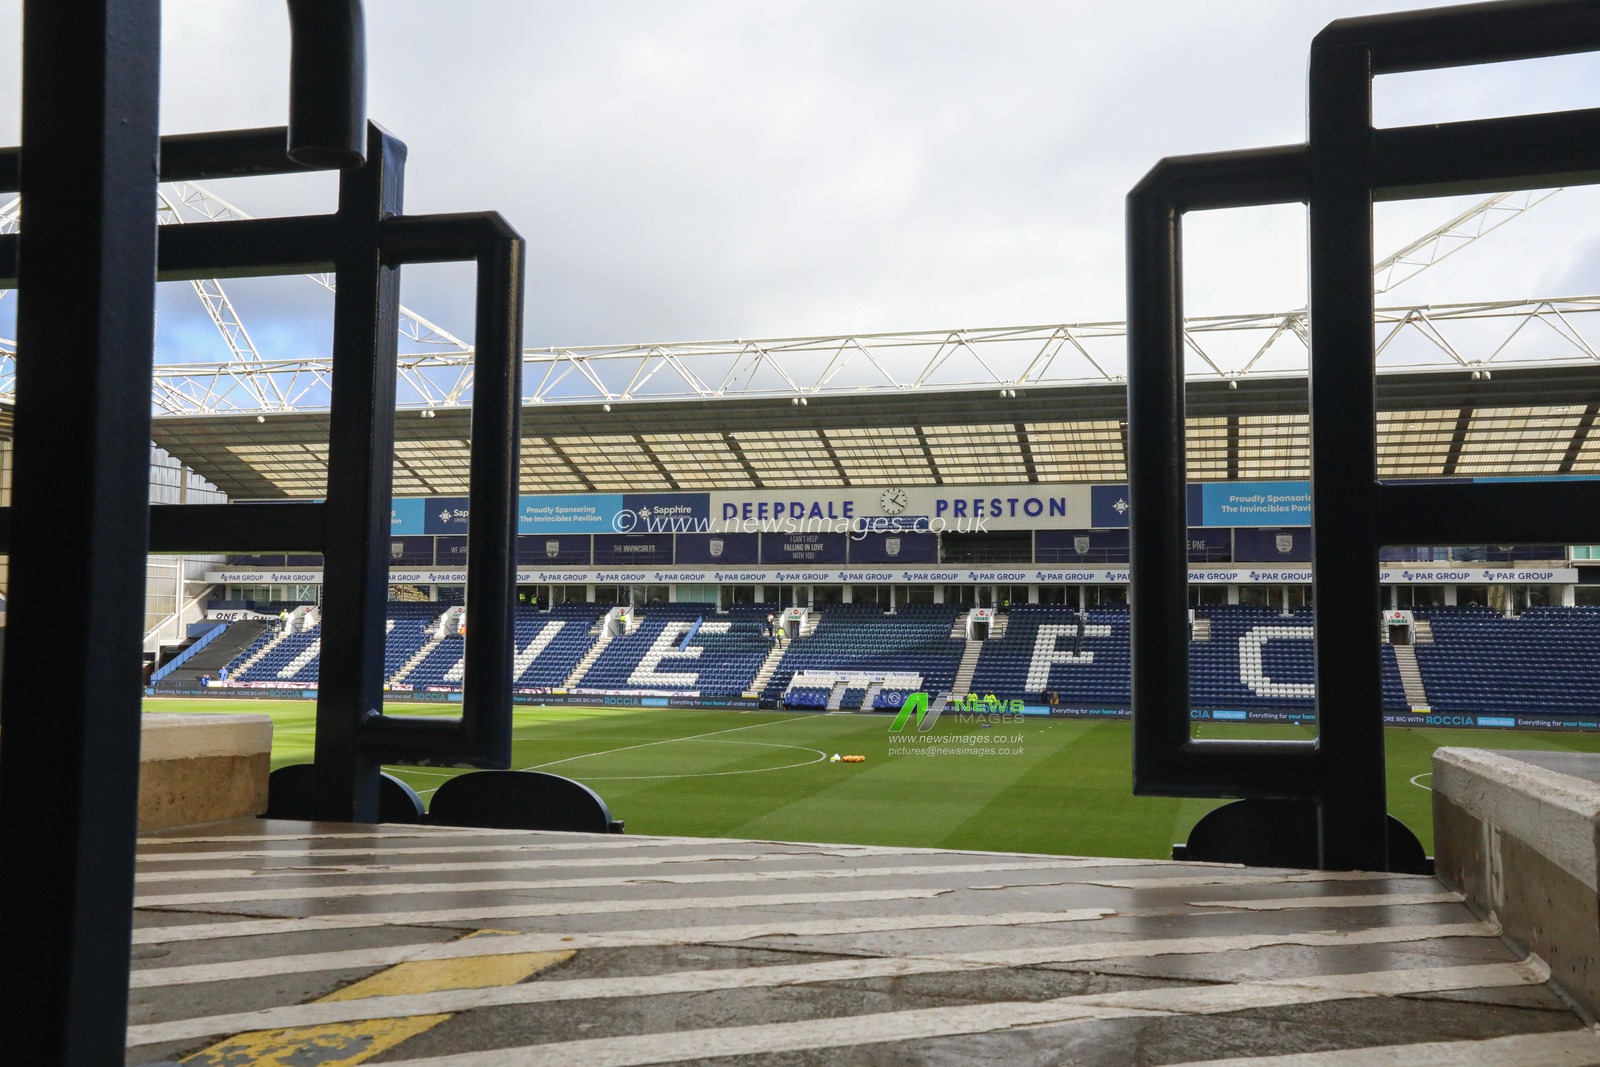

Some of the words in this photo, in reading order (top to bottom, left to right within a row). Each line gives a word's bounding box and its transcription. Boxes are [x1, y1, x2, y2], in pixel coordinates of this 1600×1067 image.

[1229, 495, 1265, 504] Proudly
[526, 506, 554, 514] Proudly
[654, 505, 692, 515] Sapphire
[723, 501, 854, 520] DEEPDALE
[936, 497, 1066, 517] PRESTON
[1221, 505, 1238, 513] The
[1240, 504, 1290, 512] Invincibles
[1291, 504, 1311, 512] Pavi
[1190, 710, 1210, 718] CIA
[1426, 716, 1474, 725] ROCCIA
